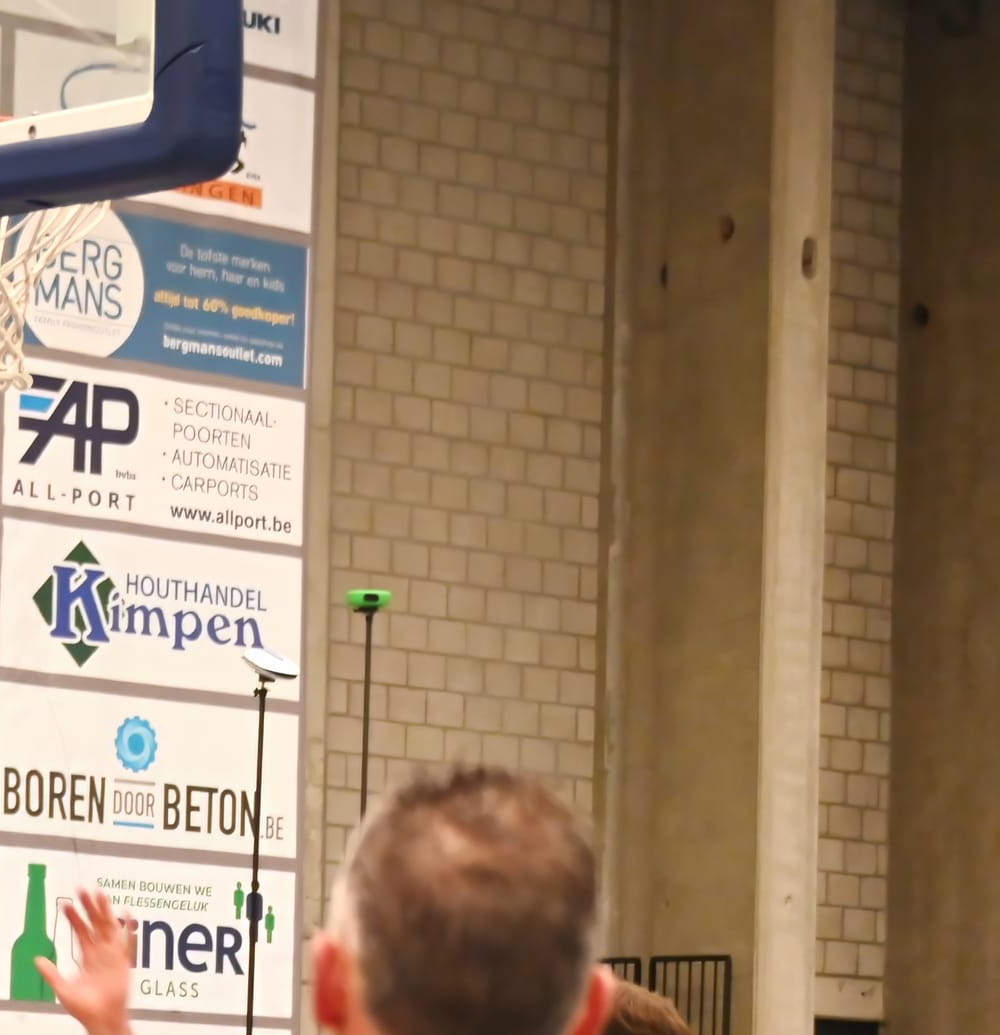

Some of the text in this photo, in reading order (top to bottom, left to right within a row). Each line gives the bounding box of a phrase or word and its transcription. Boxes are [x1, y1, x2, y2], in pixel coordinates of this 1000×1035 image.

[231, 255, 271, 273] merken
[34, 273, 122, 320] MANS
[183, 295, 199, 310] tot
[202, 298, 229, 315] 60%
[231, 305, 295, 327] goedkoper!
[162, 333, 284, 367] bergmansoutlet.com
[172, 422, 252, 450] POORTEN
[171, 448, 292, 481] AUTOMATISATIE
[12, 478, 137, 512] ALL-PORT
[170, 474, 260, 501] CARPORTS
[169, 505, 292, 533] www.allport.be
[50, 565, 265, 651] Kimpen
[126, 573, 268, 612] HOUTHANDEL
[3, 766, 107, 824] BOREN
[112, 789, 156, 818] DOOR
[96, 877, 213, 897] SAMEN BOUWEN WE
[140, 979, 200, 999] GLASS
